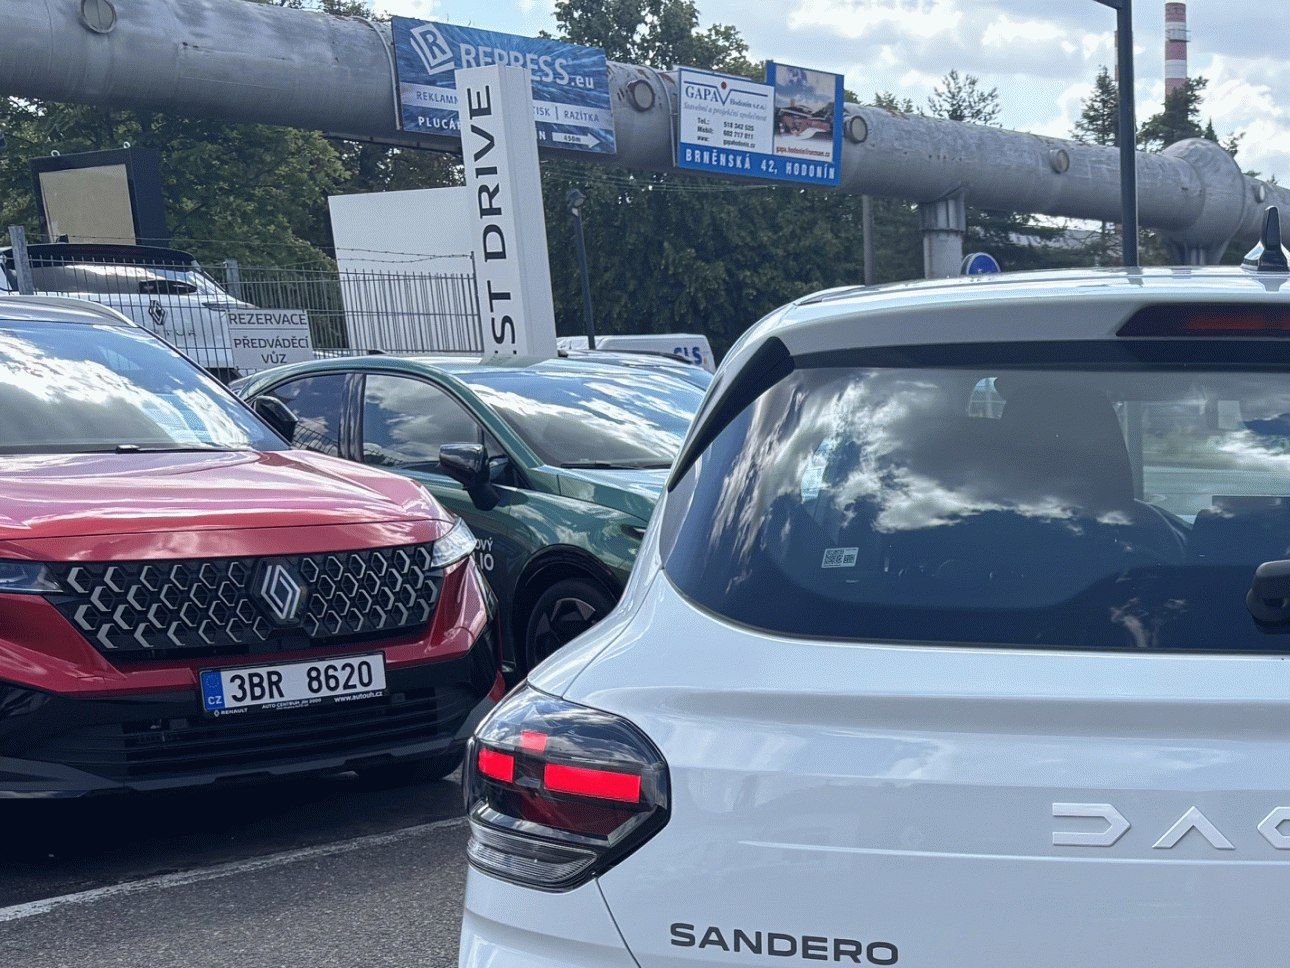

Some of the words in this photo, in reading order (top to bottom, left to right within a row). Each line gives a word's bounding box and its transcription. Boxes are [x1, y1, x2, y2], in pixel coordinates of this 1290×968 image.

[533, 105, 551, 117] ISK
[564, 110, 600, 122] RAZÍTKA
[685, 148, 751, 170] BRNĚNSKÁ
[760, 159, 778, 175] 42,
[786, 161, 835, 180] HODONÍN
[467, 85, 507, 262] DRIVE
[229, 313, 307, 325] REZERVACE
[487, 280, 517, 355] ST
[233, 335, 309, 349] PŘEDVÁDĚCÍ
[261, 351, 287, 364] VŮZ
[475, 537, 493, 551] OVÝ
[229, 670, 285, 703] 3BR
[306, 660, 373, 694] 8620
[207, 695, 223, 705] CZ
[333, 691, 383, 703] www.autouh.cz
[220, 707, 248, 715] RENAULT
[670, 922, 899, 966] SANDERO
